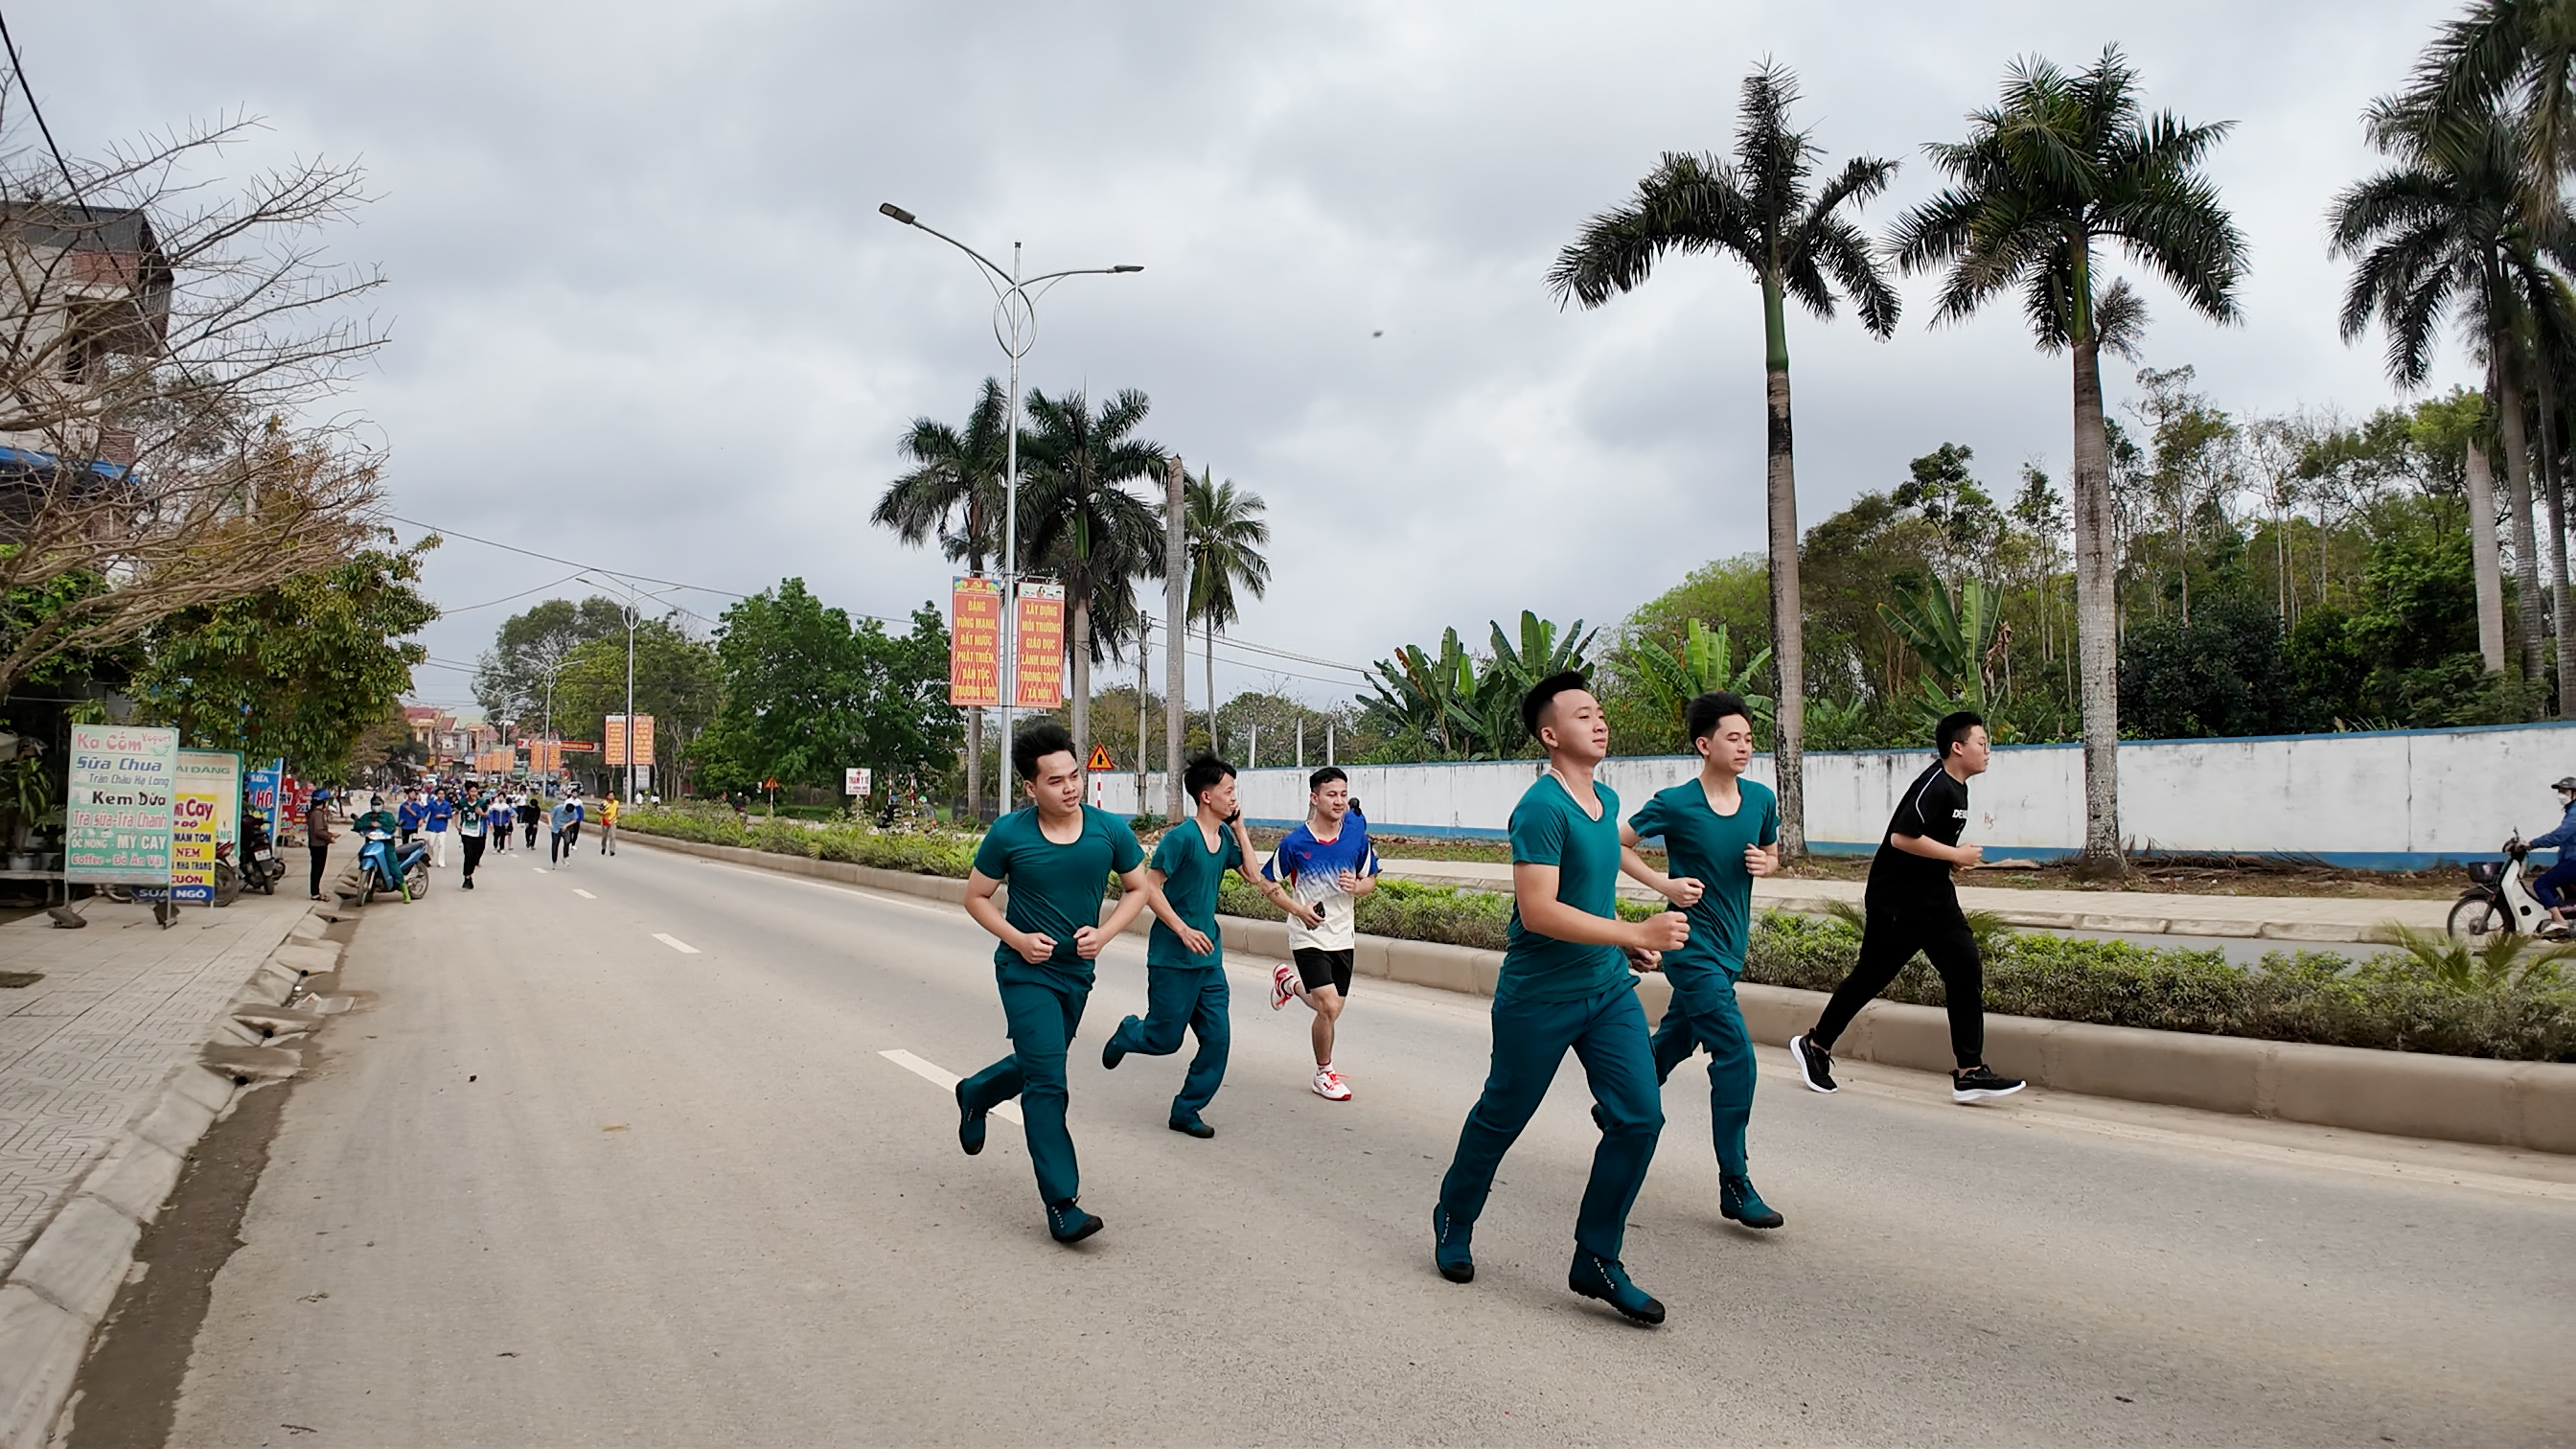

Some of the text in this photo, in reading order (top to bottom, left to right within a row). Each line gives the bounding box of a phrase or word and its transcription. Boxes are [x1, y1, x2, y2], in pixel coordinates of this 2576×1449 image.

[76, 756, 163, 772] Sữa Chua
[149, 775, 171, 788] Long
[92, 791, 167, 806] Kem Dừa
[186, 798, 214, 821] Cay
[137, 812, 168, 829] Chanh
[141, 836, 167, 850] CAY
[71, 854, 104, 865] Coffee
[175, 847, 201, 858] NEM
[175, 889, 207, 898] NGÔ
